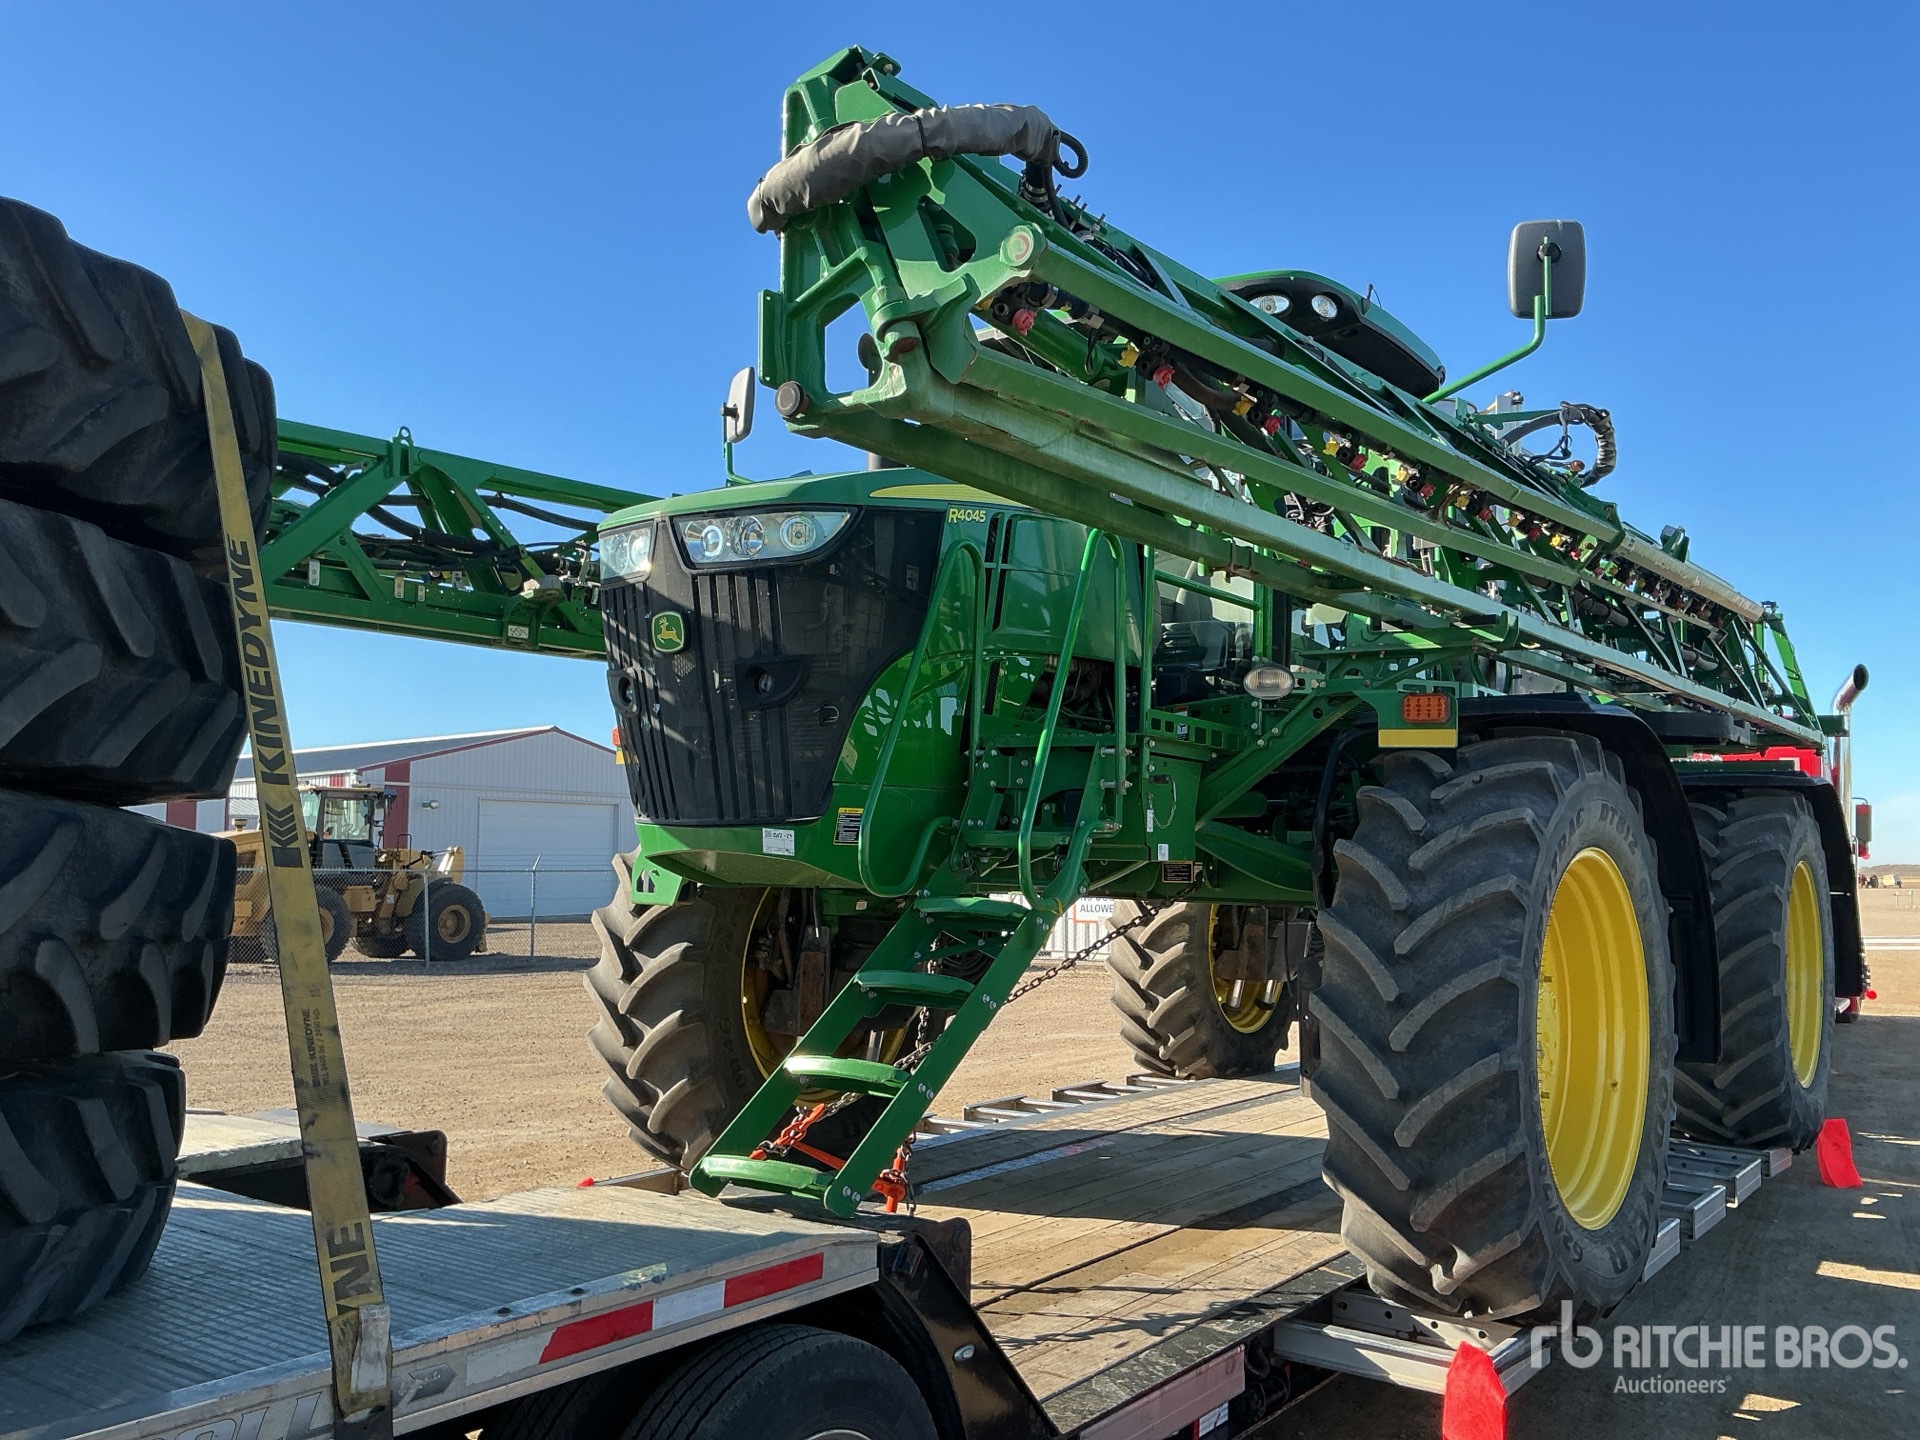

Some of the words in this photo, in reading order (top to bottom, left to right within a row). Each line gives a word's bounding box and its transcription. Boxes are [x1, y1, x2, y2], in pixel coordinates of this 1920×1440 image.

[948, 508, 986, 523] R4045
[226, 533, 290, 786] KINEDYNE
[1080, 904, 1114, 913] ALLOWE
[301, 1007, 316, 1061] KINEDYNE
